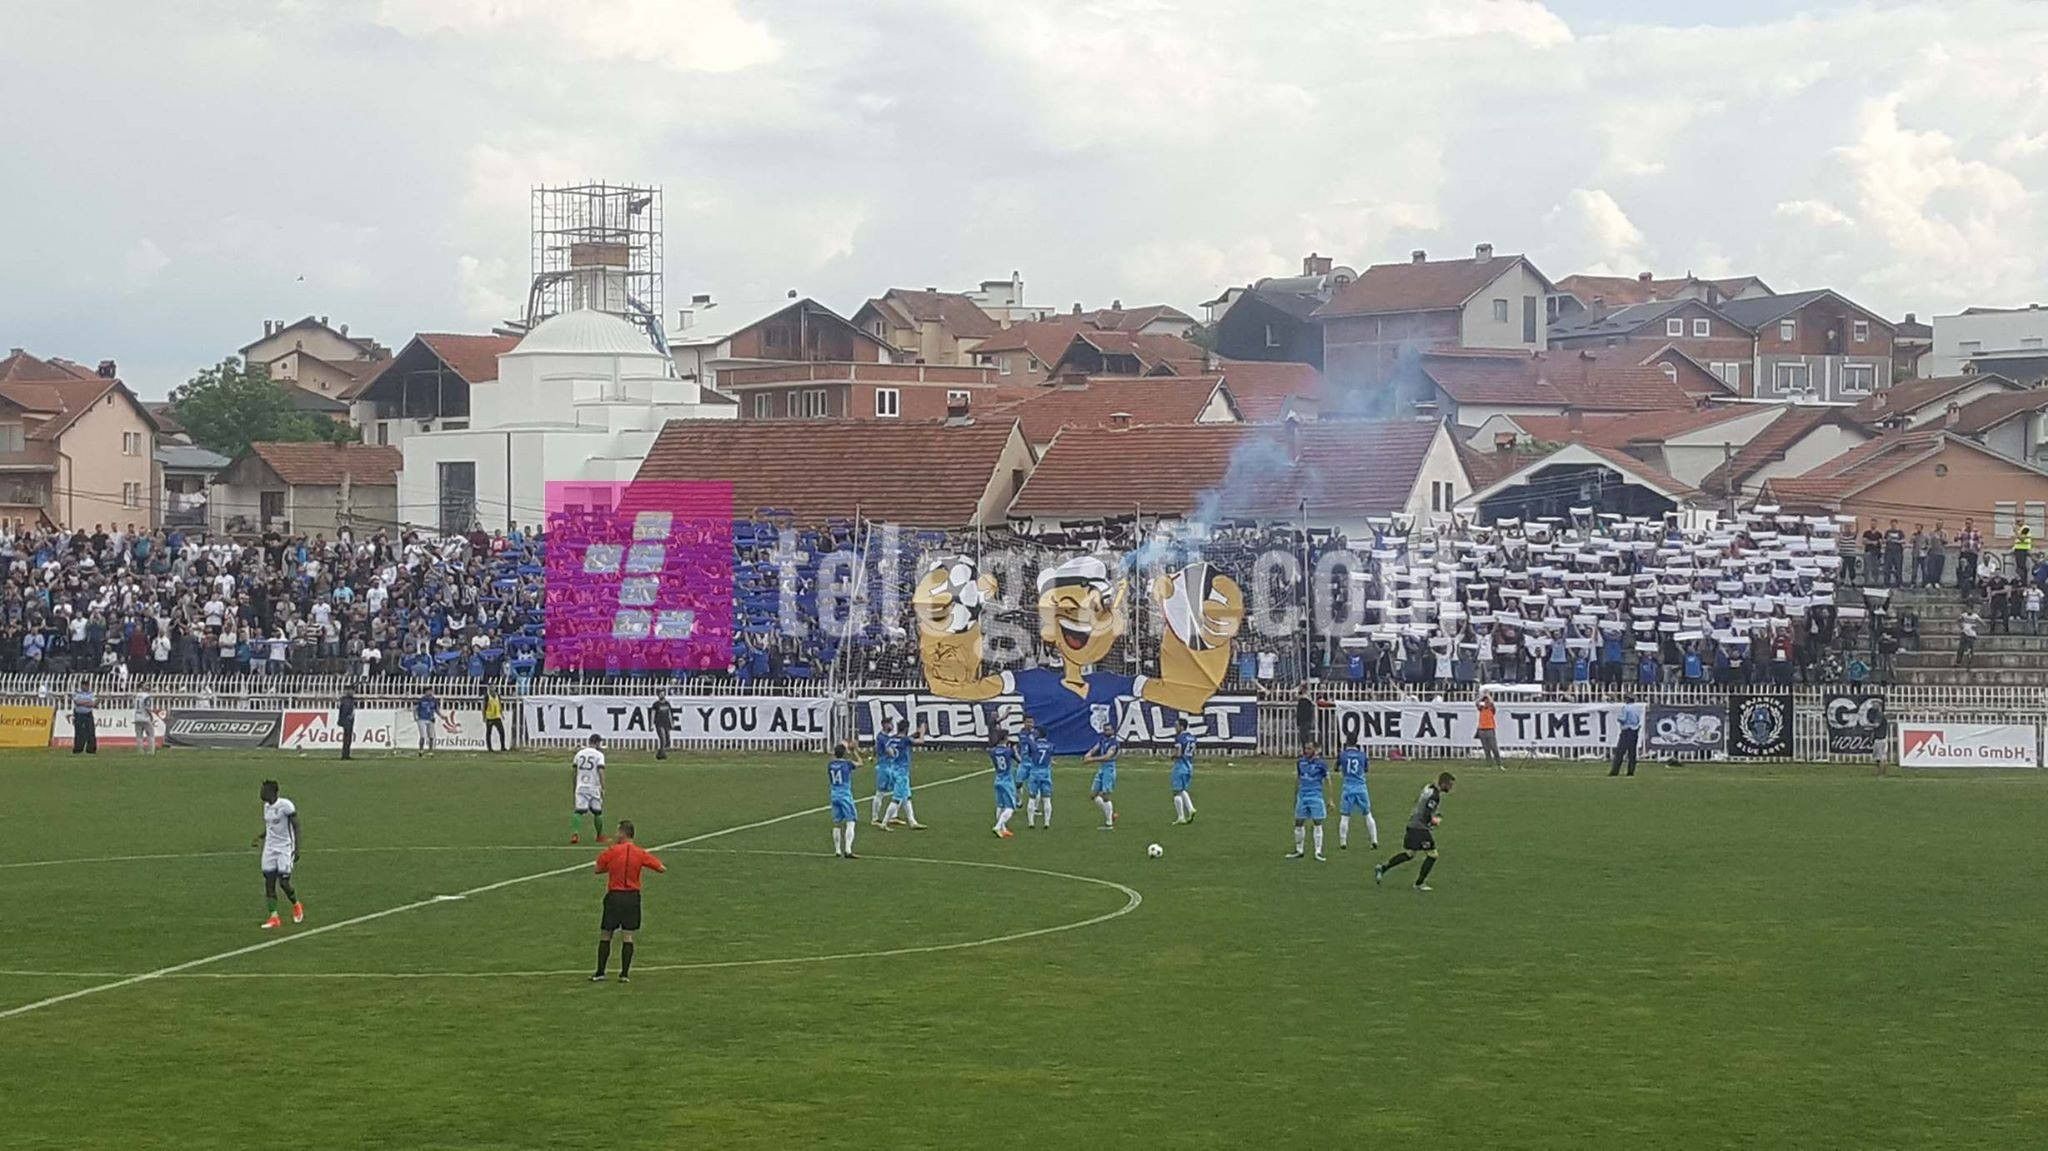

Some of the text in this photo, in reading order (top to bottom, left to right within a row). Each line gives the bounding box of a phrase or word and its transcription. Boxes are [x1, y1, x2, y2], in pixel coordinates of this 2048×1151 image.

[0, 713, 48, 728] keramika
[536, 705, 823, 734] I'LL TAE YOU ALL
[1341, 709, 1610, 742] ONE AT TIME!
[362, 730, 386, 743] AG
[1038, 749, 1046, 764] 7
[1927, 744, 2026, 759] Valon GmbH
[578, 755, 595, 771] 25
[1346, 758, 1360, 774] 13
